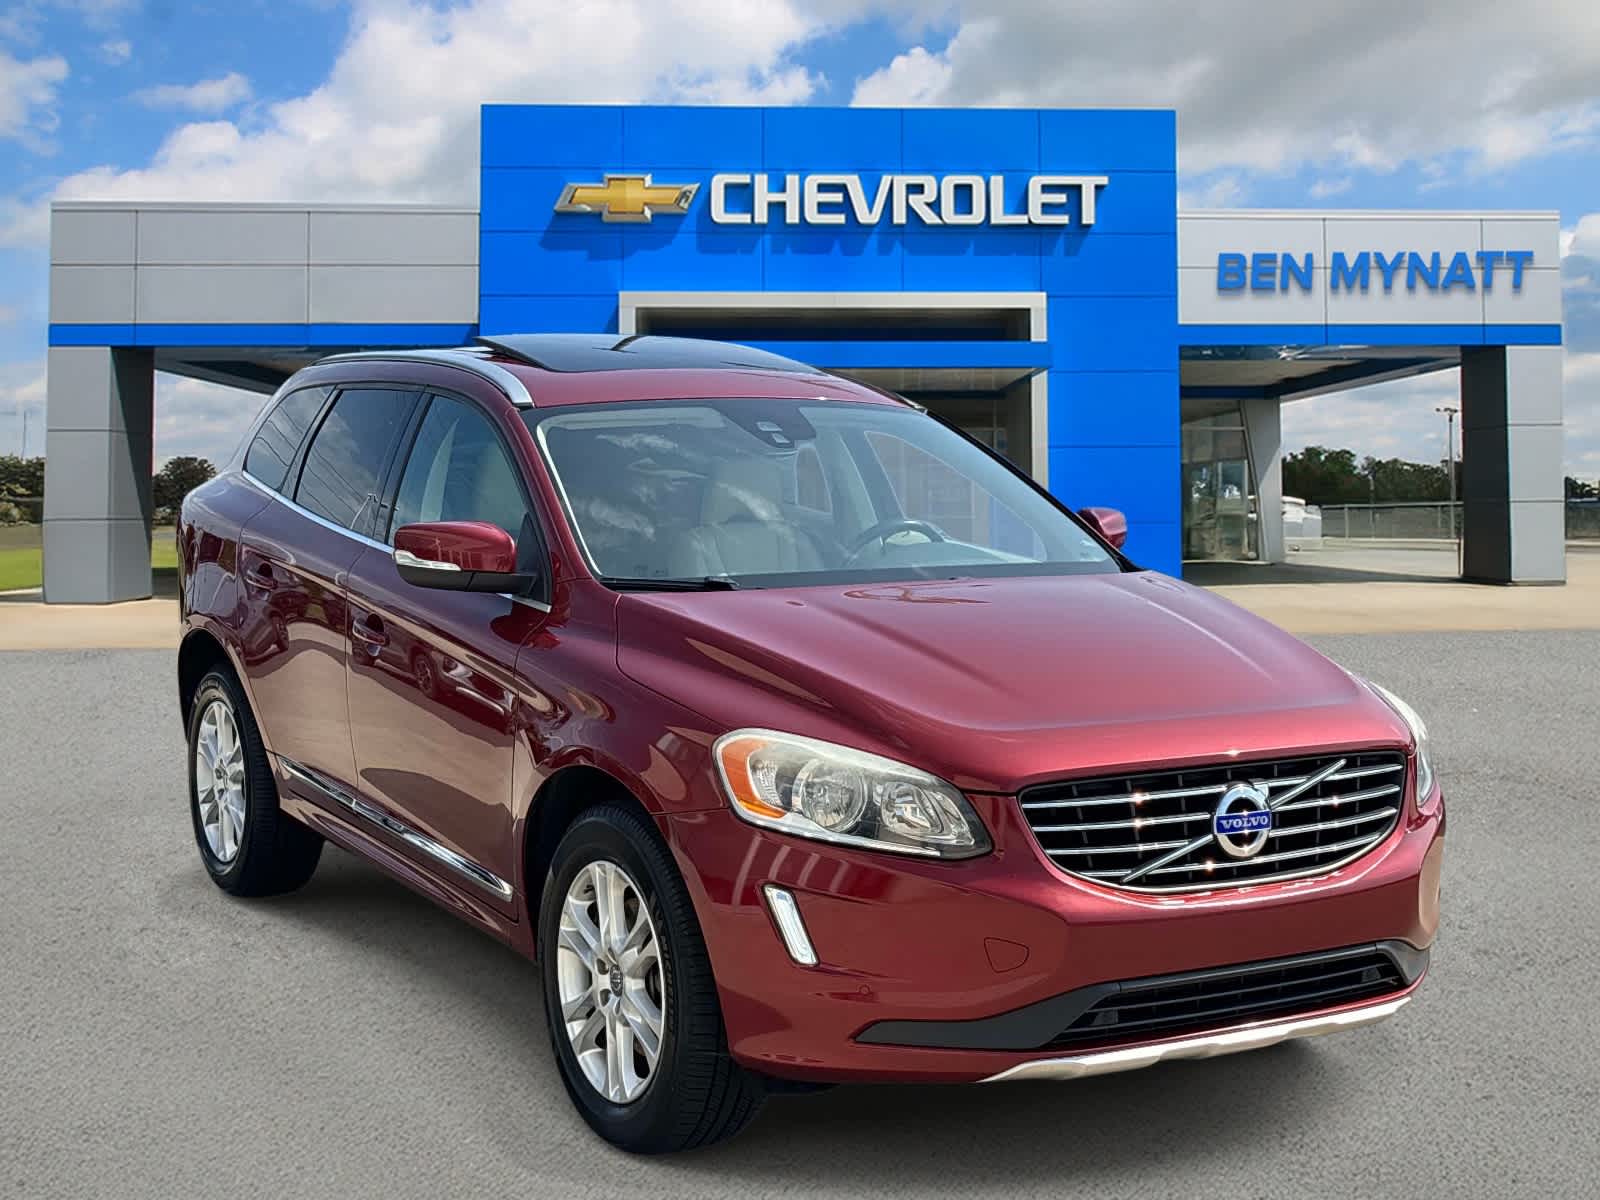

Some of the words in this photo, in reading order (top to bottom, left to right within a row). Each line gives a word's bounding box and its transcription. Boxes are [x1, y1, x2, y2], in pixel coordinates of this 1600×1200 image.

[710, 173, 1108, 226] CHEVROLET
[1217, 252, 1314, 291] BEN
[1330, 250, 1534, 291] MYNATT
[1220, 815, 1269, 829] VOLVO
